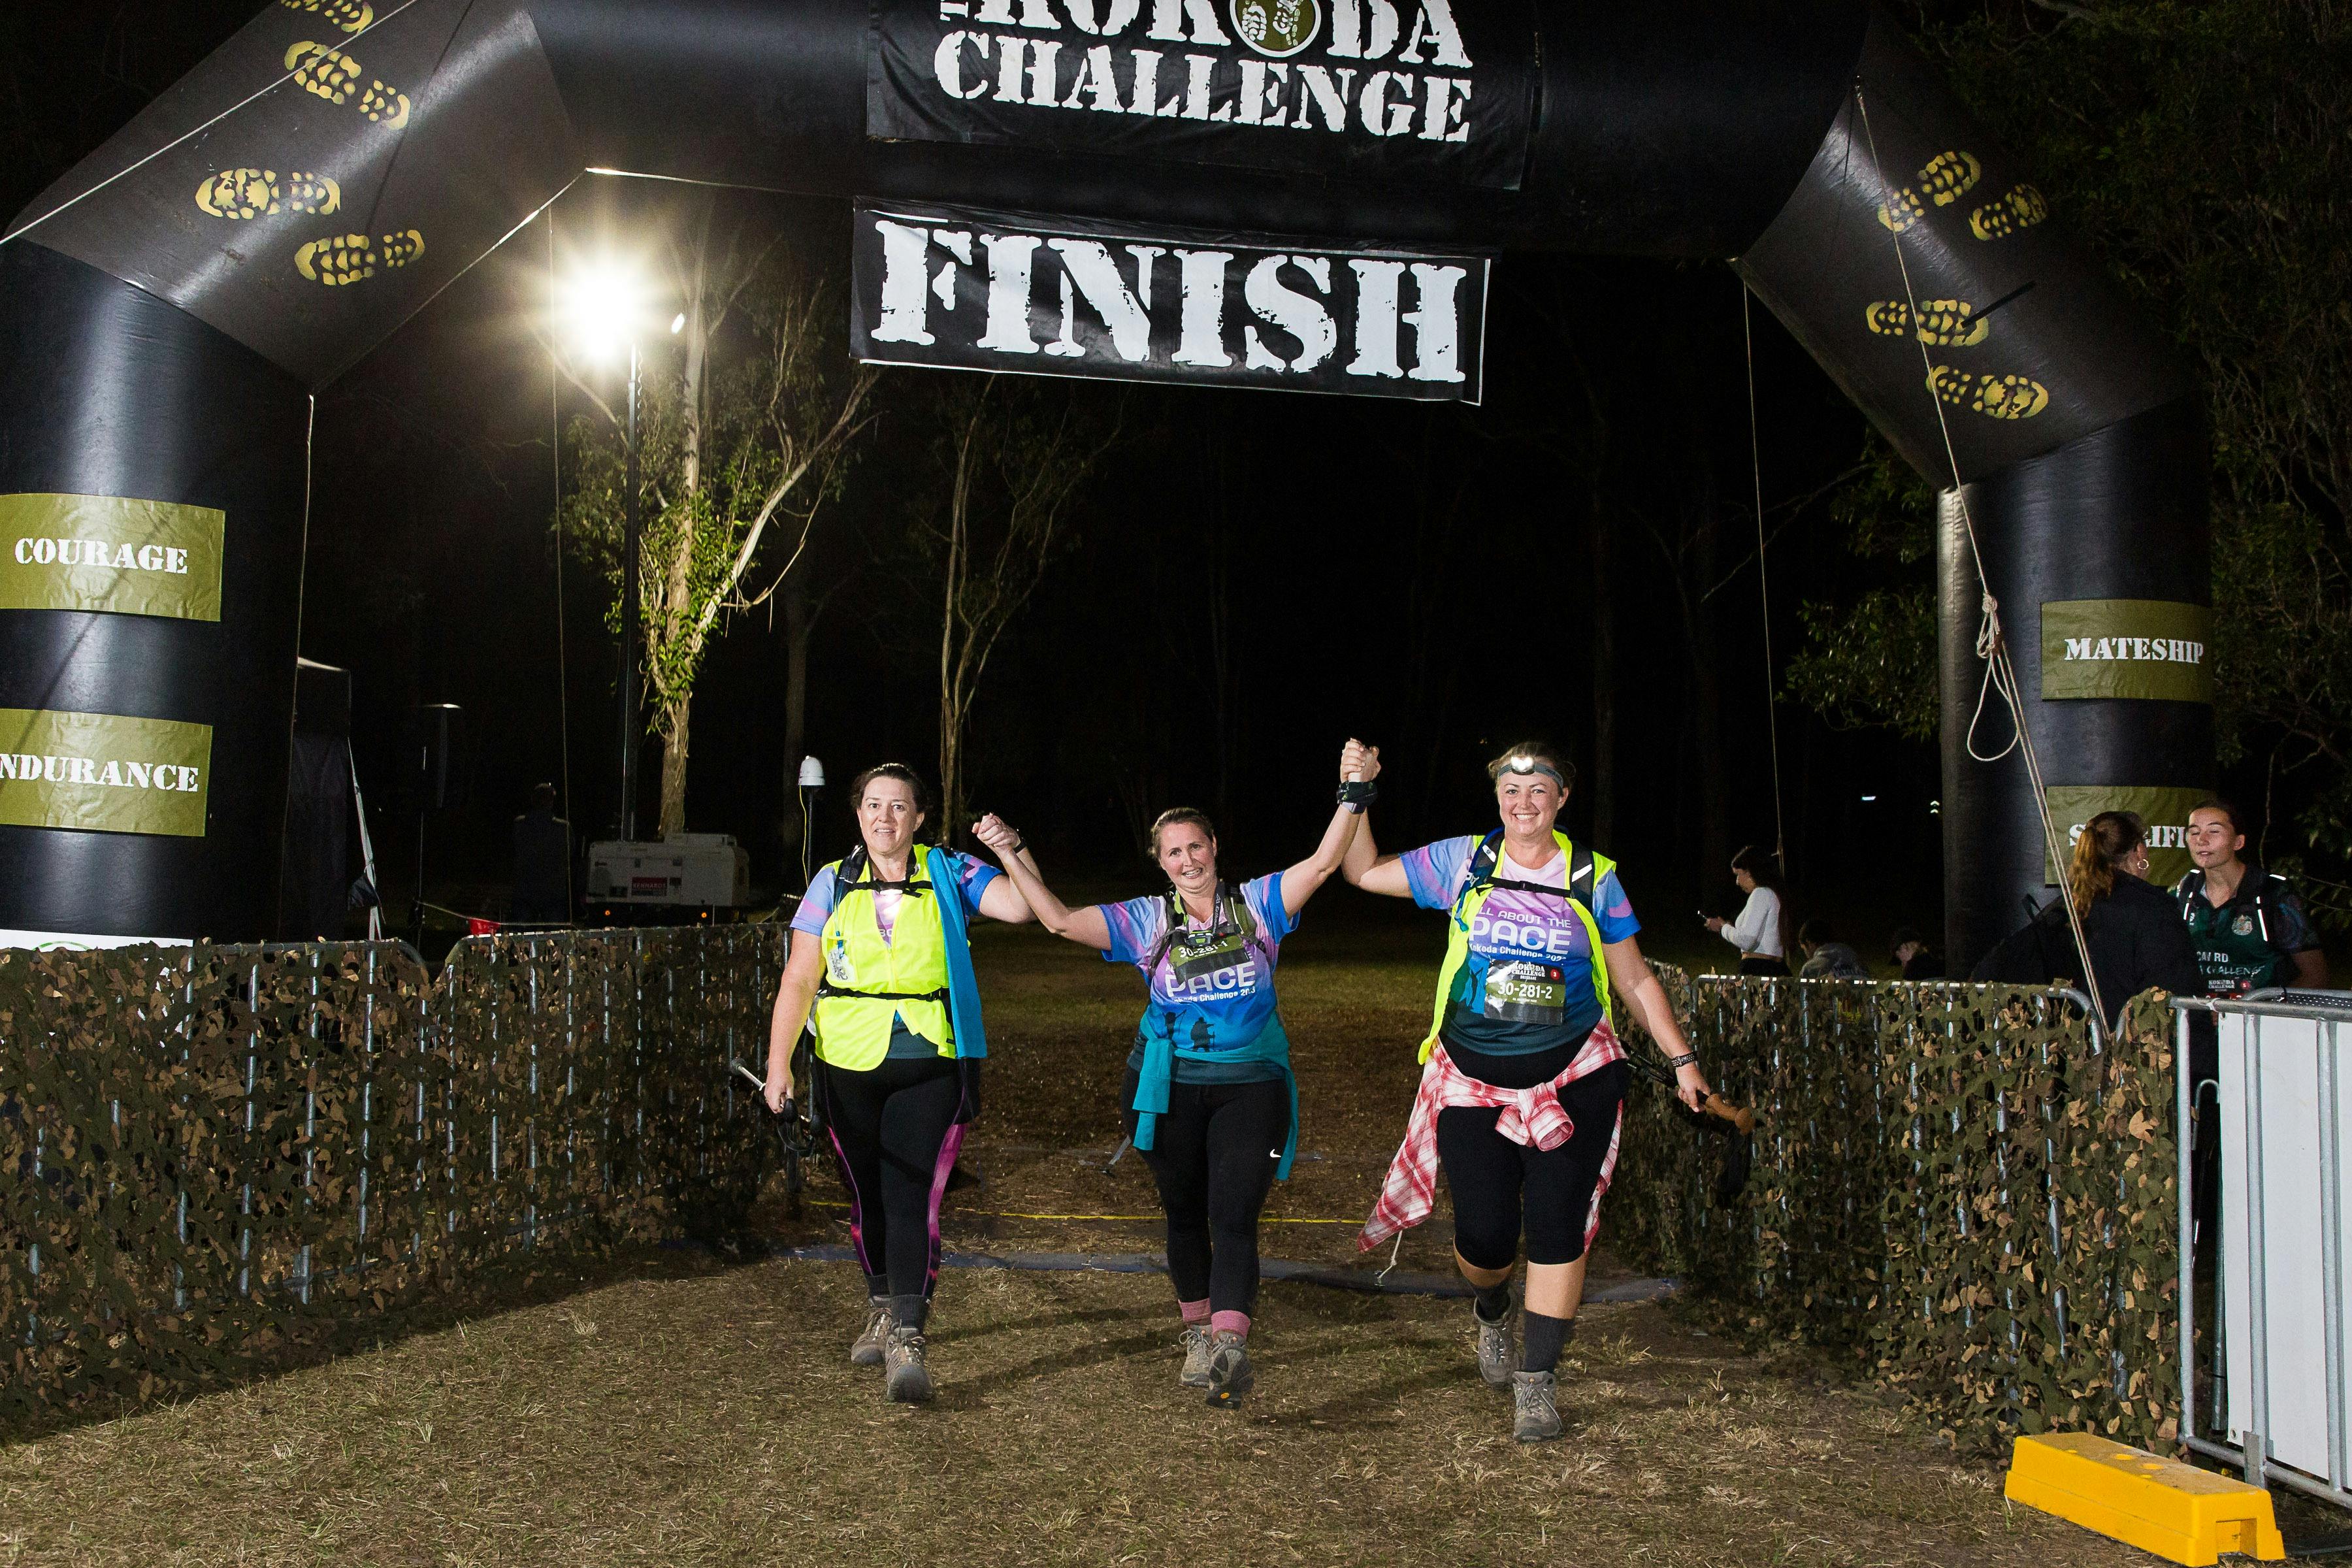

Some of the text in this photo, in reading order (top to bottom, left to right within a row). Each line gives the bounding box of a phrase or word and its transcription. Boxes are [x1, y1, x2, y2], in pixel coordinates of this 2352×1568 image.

[934, 31, 1473, 142] CHALLENGE
[870, 220, 1467, 382] FINISH
[14, 537, 188, 574] COURAGE
[2063, 636, 2204, 664] MATESHIP
[1478, 906, 1572, 928] LL ABOUT THE
[1178, 940, 1228, 958] 30-281-1
[1469, 916, 1573, 955] PACE
[2213, 952, 2229, 962] RD
[1165, 960, 1256, 998] PACE
[1497, 981, 1553, 1000] 30-281-2
[1200, 990, 1239, 1002] Challenge
